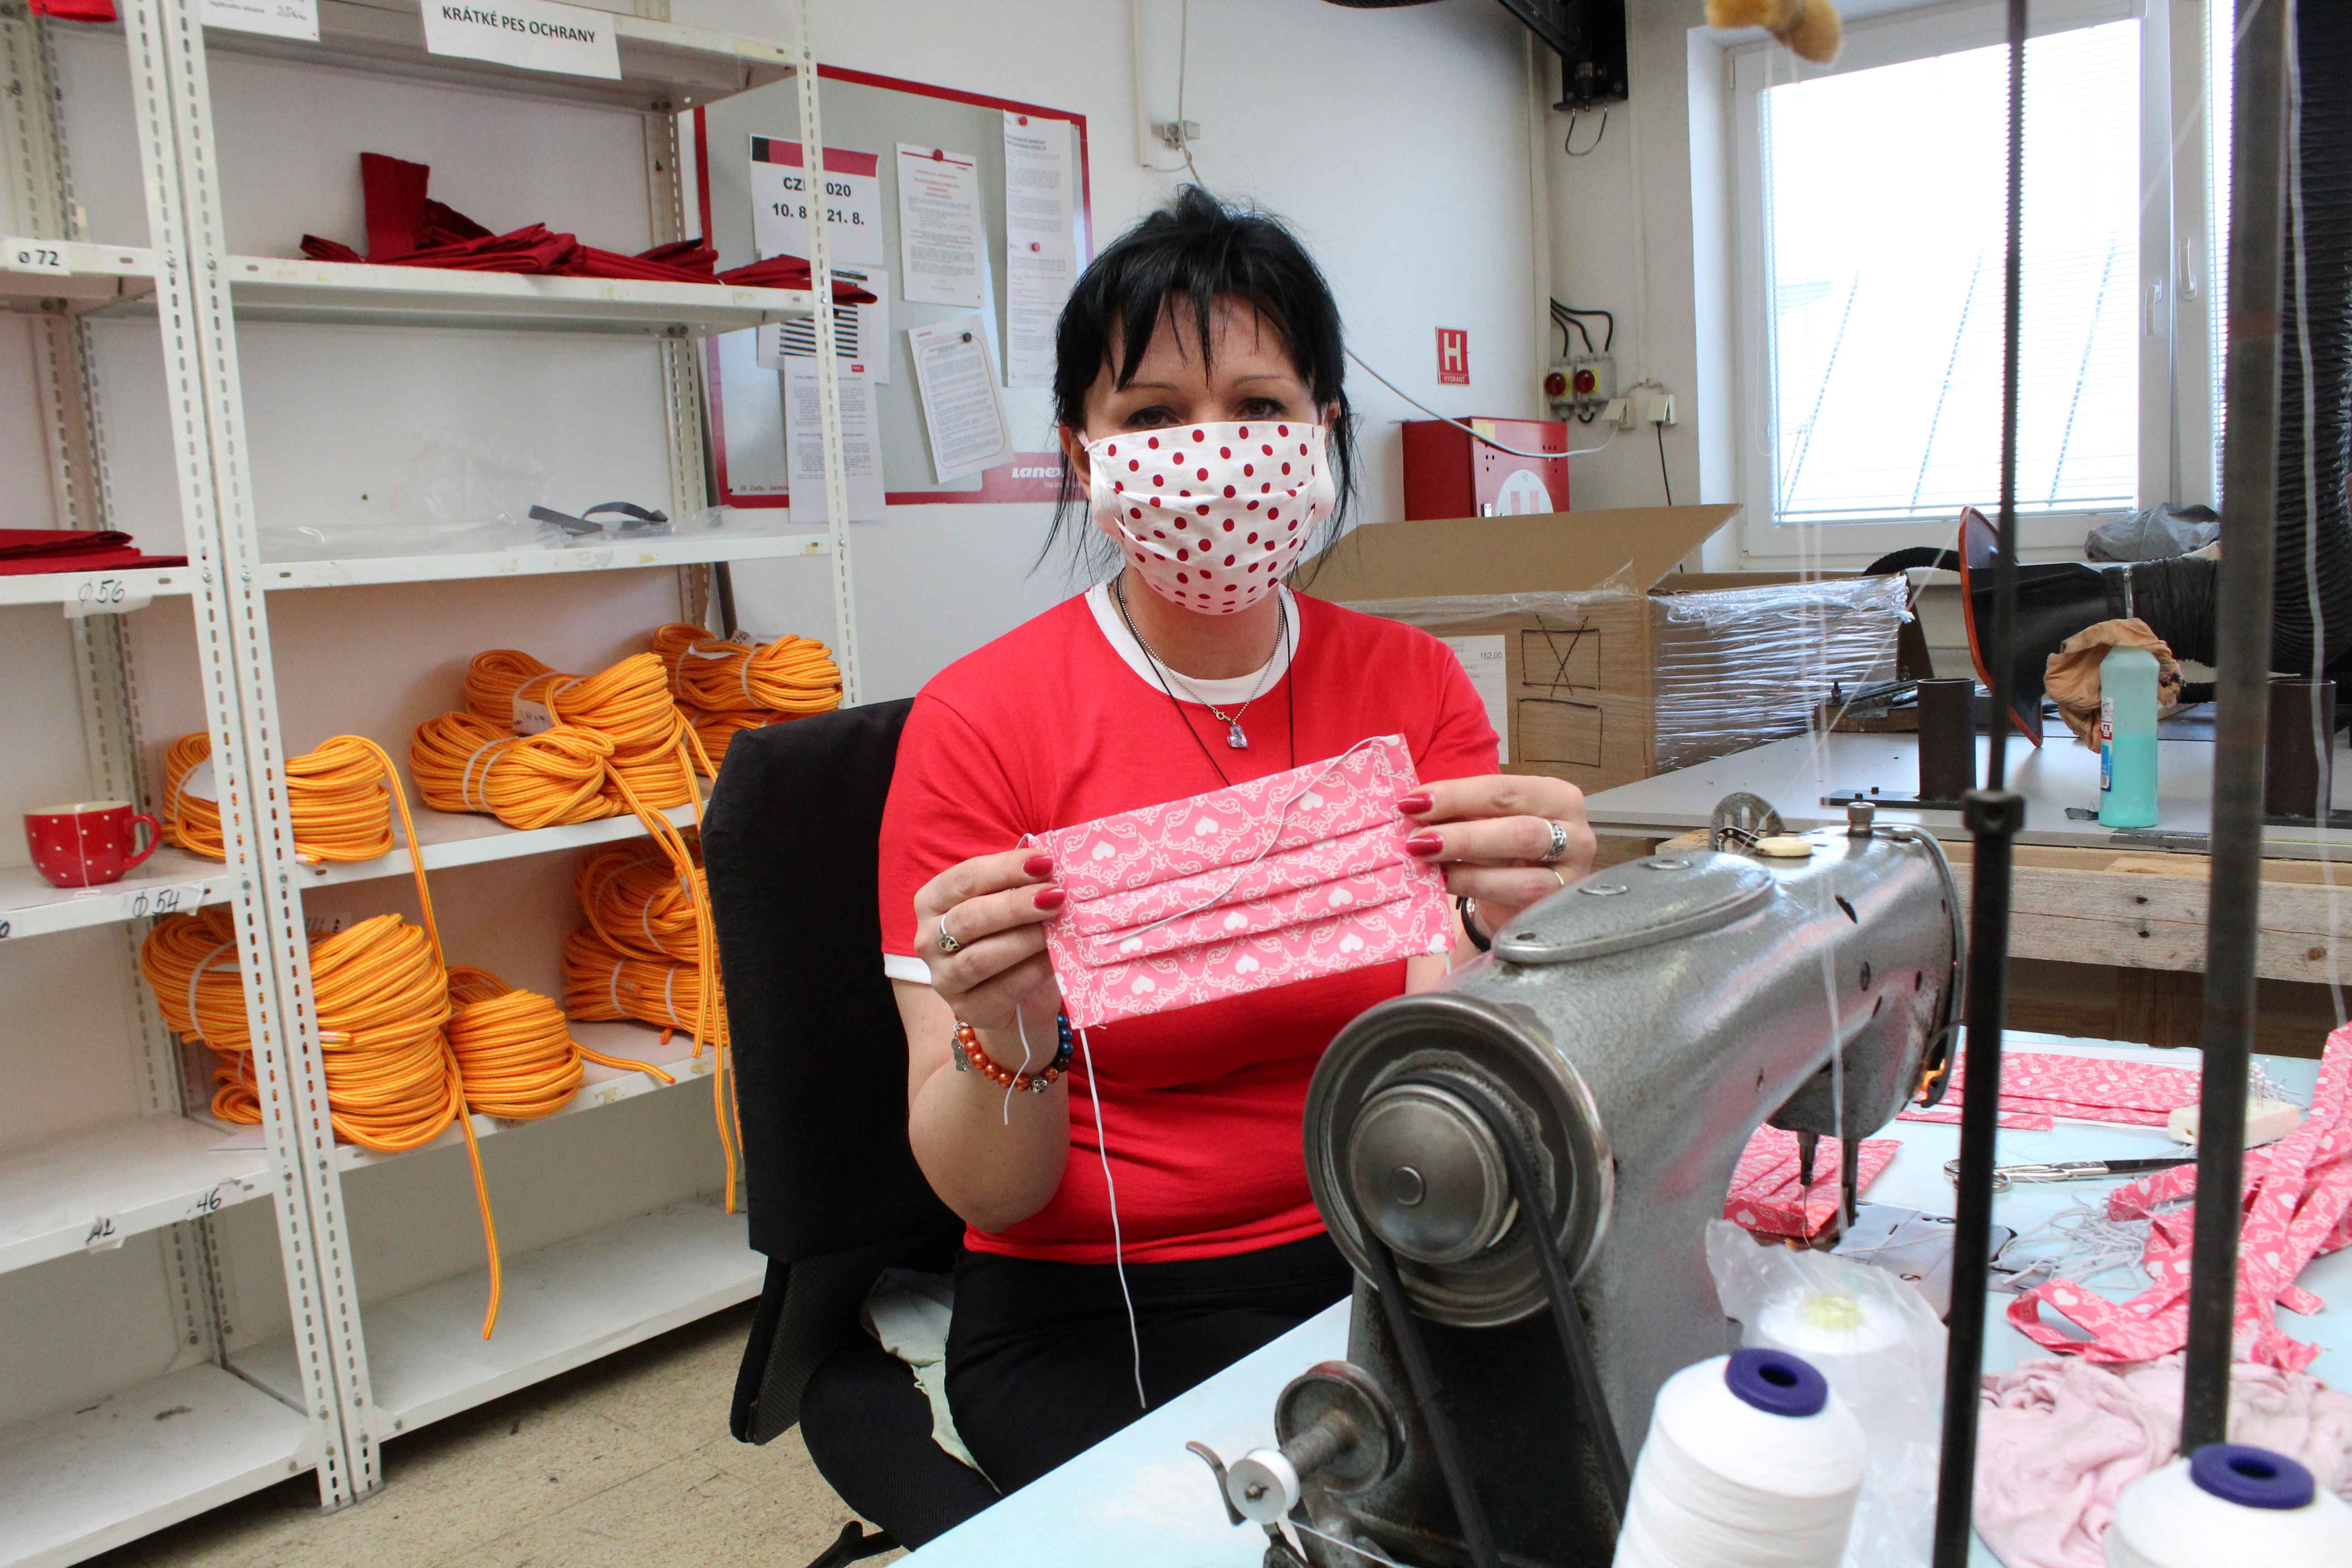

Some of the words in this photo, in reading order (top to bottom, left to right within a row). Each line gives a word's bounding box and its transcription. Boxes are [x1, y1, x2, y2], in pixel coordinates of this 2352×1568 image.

[442, 6, 498, 27] KRÁTKÉ
[502, 15, 525, 32] PES
[529, 21, 596, 44] OCHRANY
[783, 176, 806, 191] CZ
[824, 181, 851, 197] 020
[773, 203, 794, 217] 10.
[827, 209, 848, 223] 21.
[853, 212, 864, 225] 8.
[36, 249, 60, 266] 72
[1444, 333, 1462, 371] H
[152, 889, 180, 914] 54
